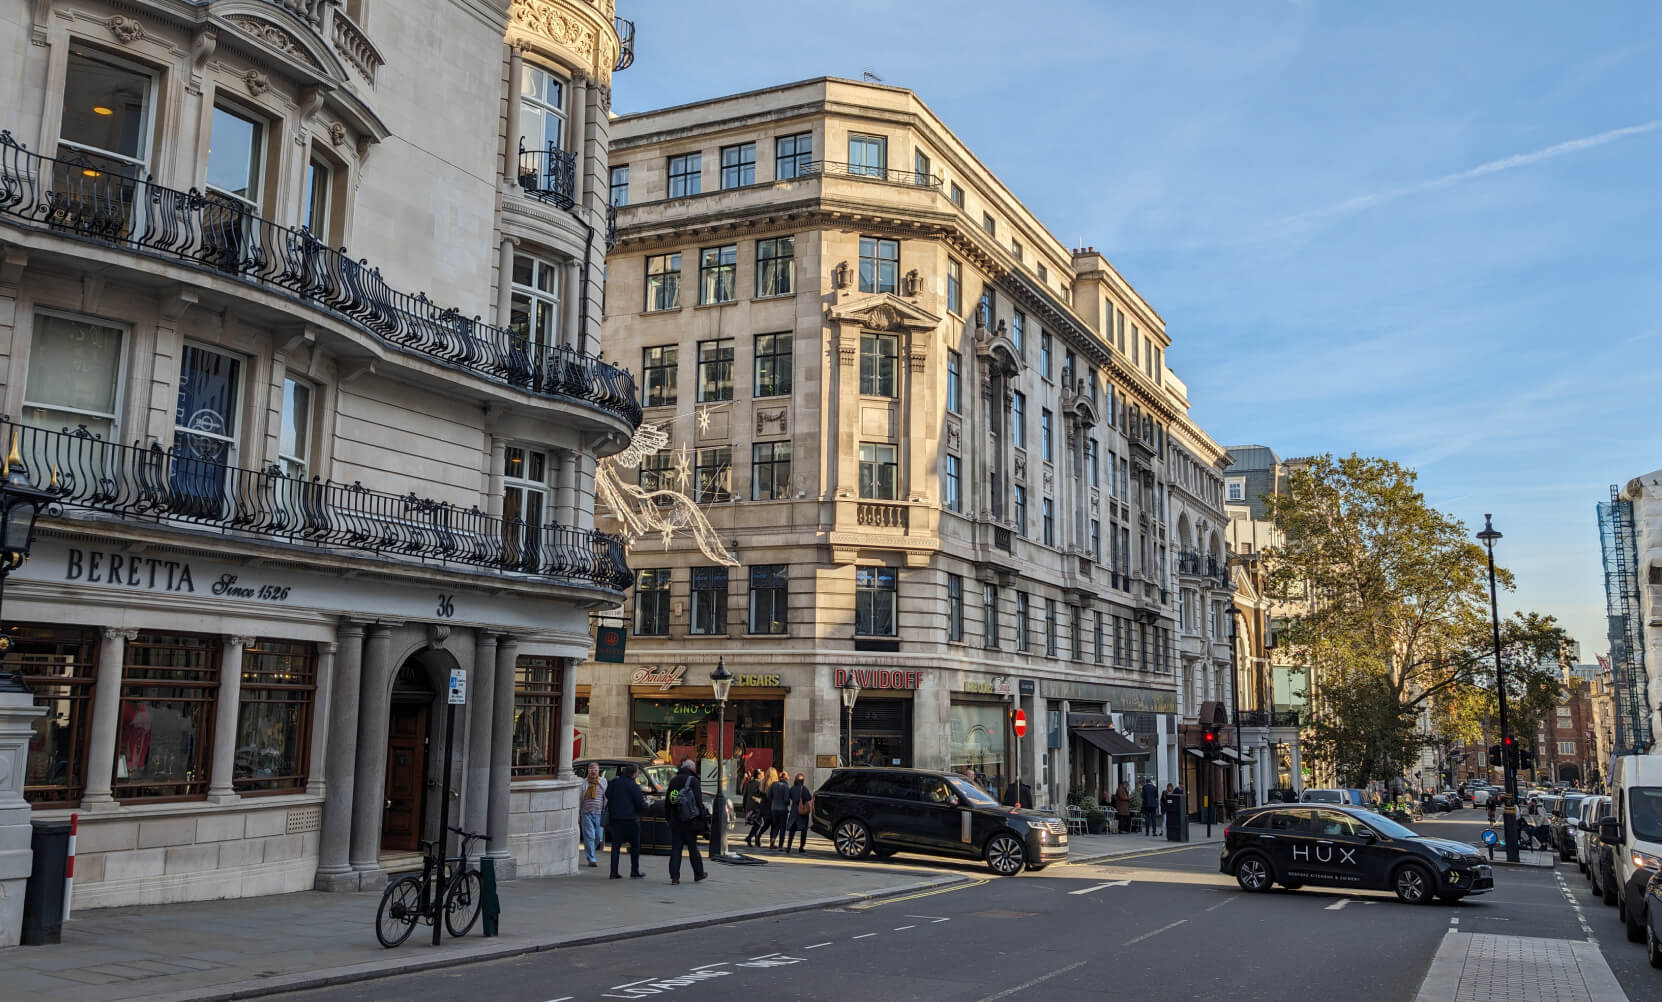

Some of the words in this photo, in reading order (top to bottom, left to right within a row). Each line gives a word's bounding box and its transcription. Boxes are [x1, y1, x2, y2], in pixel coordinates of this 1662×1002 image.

[66, 549, 194, 592] BERETTA
[212, 574, 255, 598] Since
[257, 585, 291, 600] 1526
[437, 594, 454, 617] 36
[631, 665, 687, 690] Davidoff
[738, 674, 780, 687] CIGARS
[1293, 844, 1356, 864] HUX
[600, 970, 734, 999] LOADING
